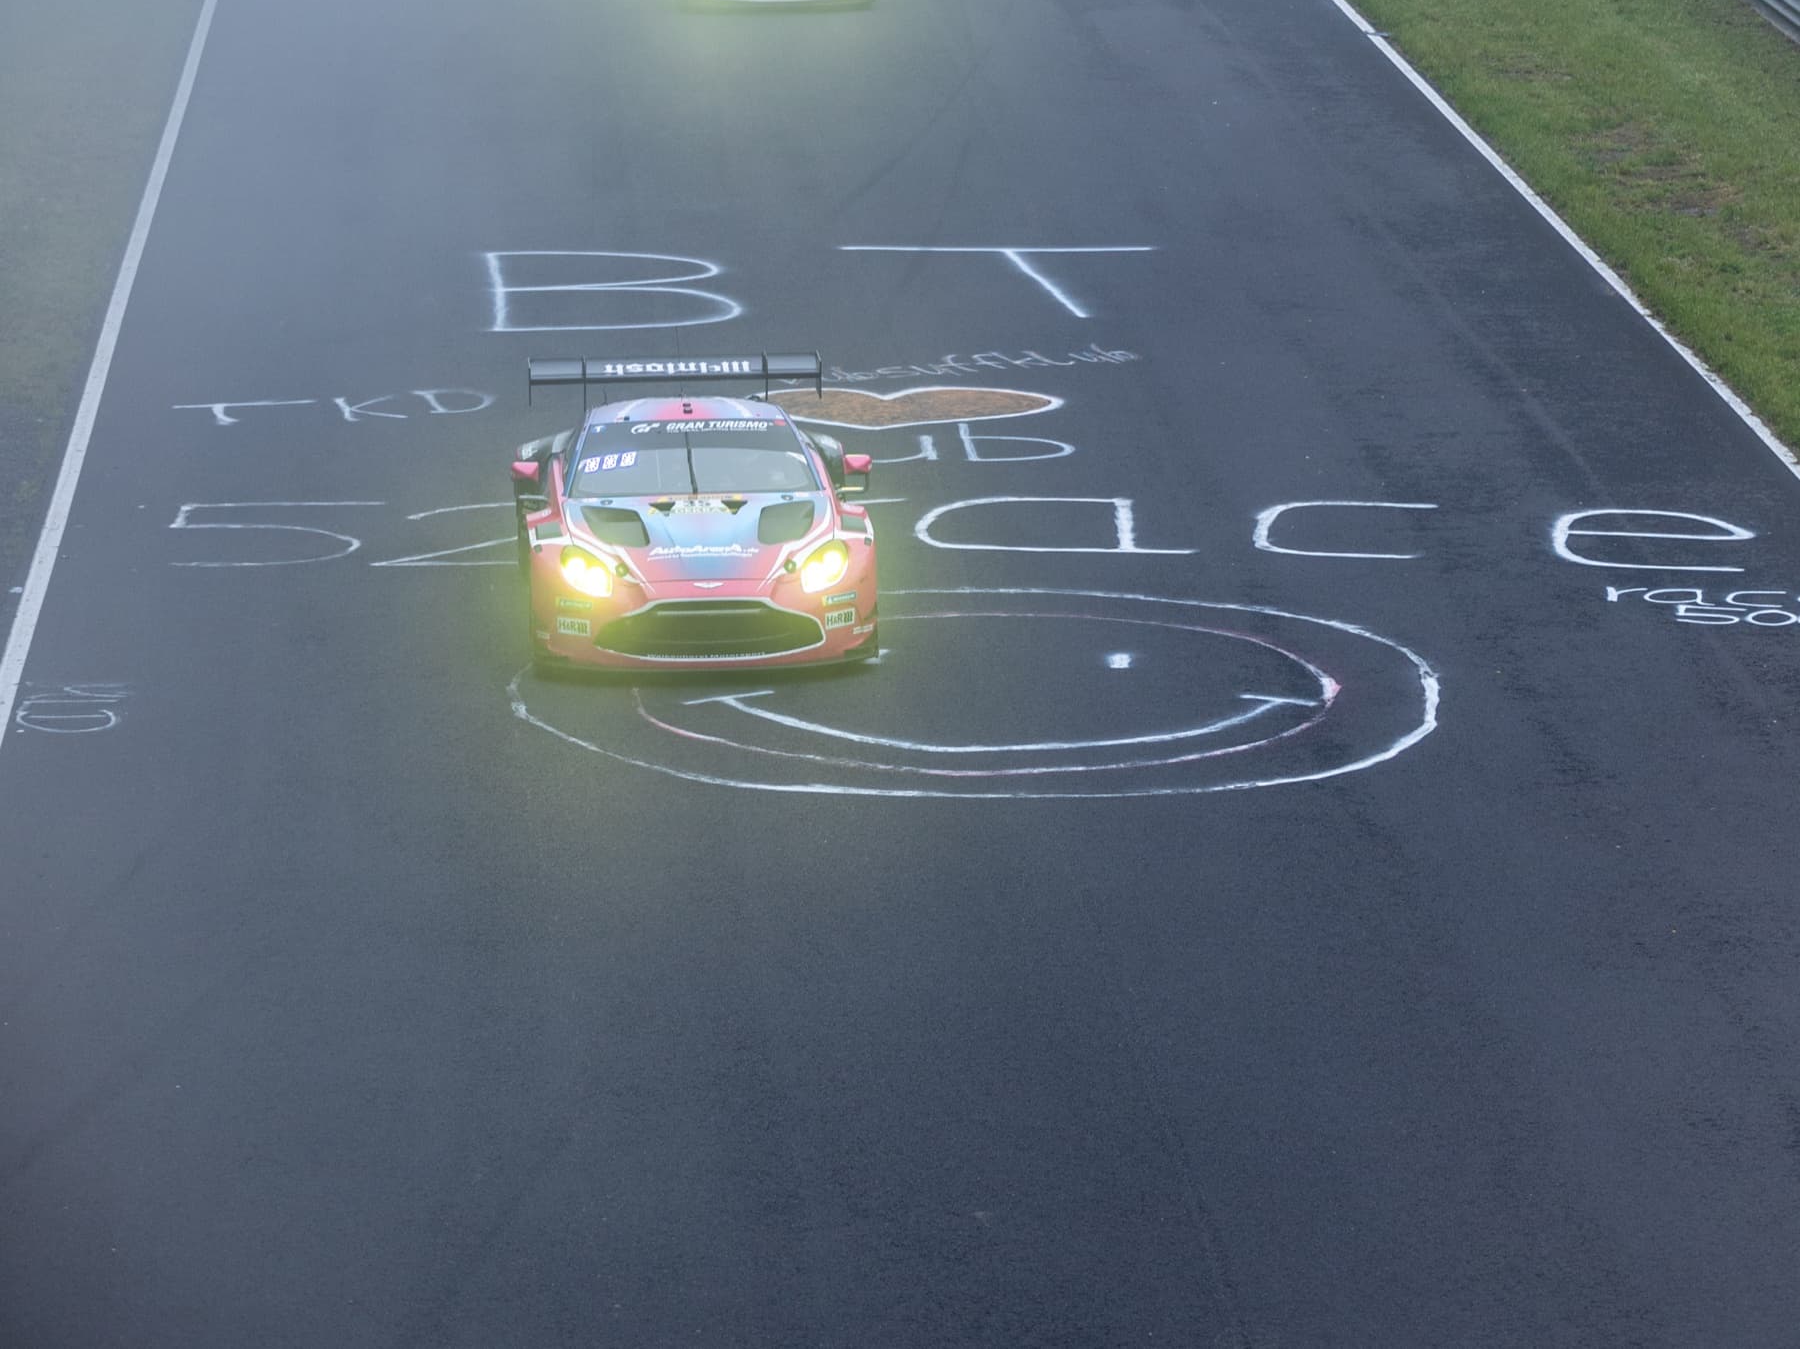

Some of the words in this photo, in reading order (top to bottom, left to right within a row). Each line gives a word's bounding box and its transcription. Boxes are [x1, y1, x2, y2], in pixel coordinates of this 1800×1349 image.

[666, 422, 705, 431] GRAN
[708, 420, 769, 430] TURISMO
[1605, 585, 1800, 608] rac
[1675, 603, 1800, 627] 50
